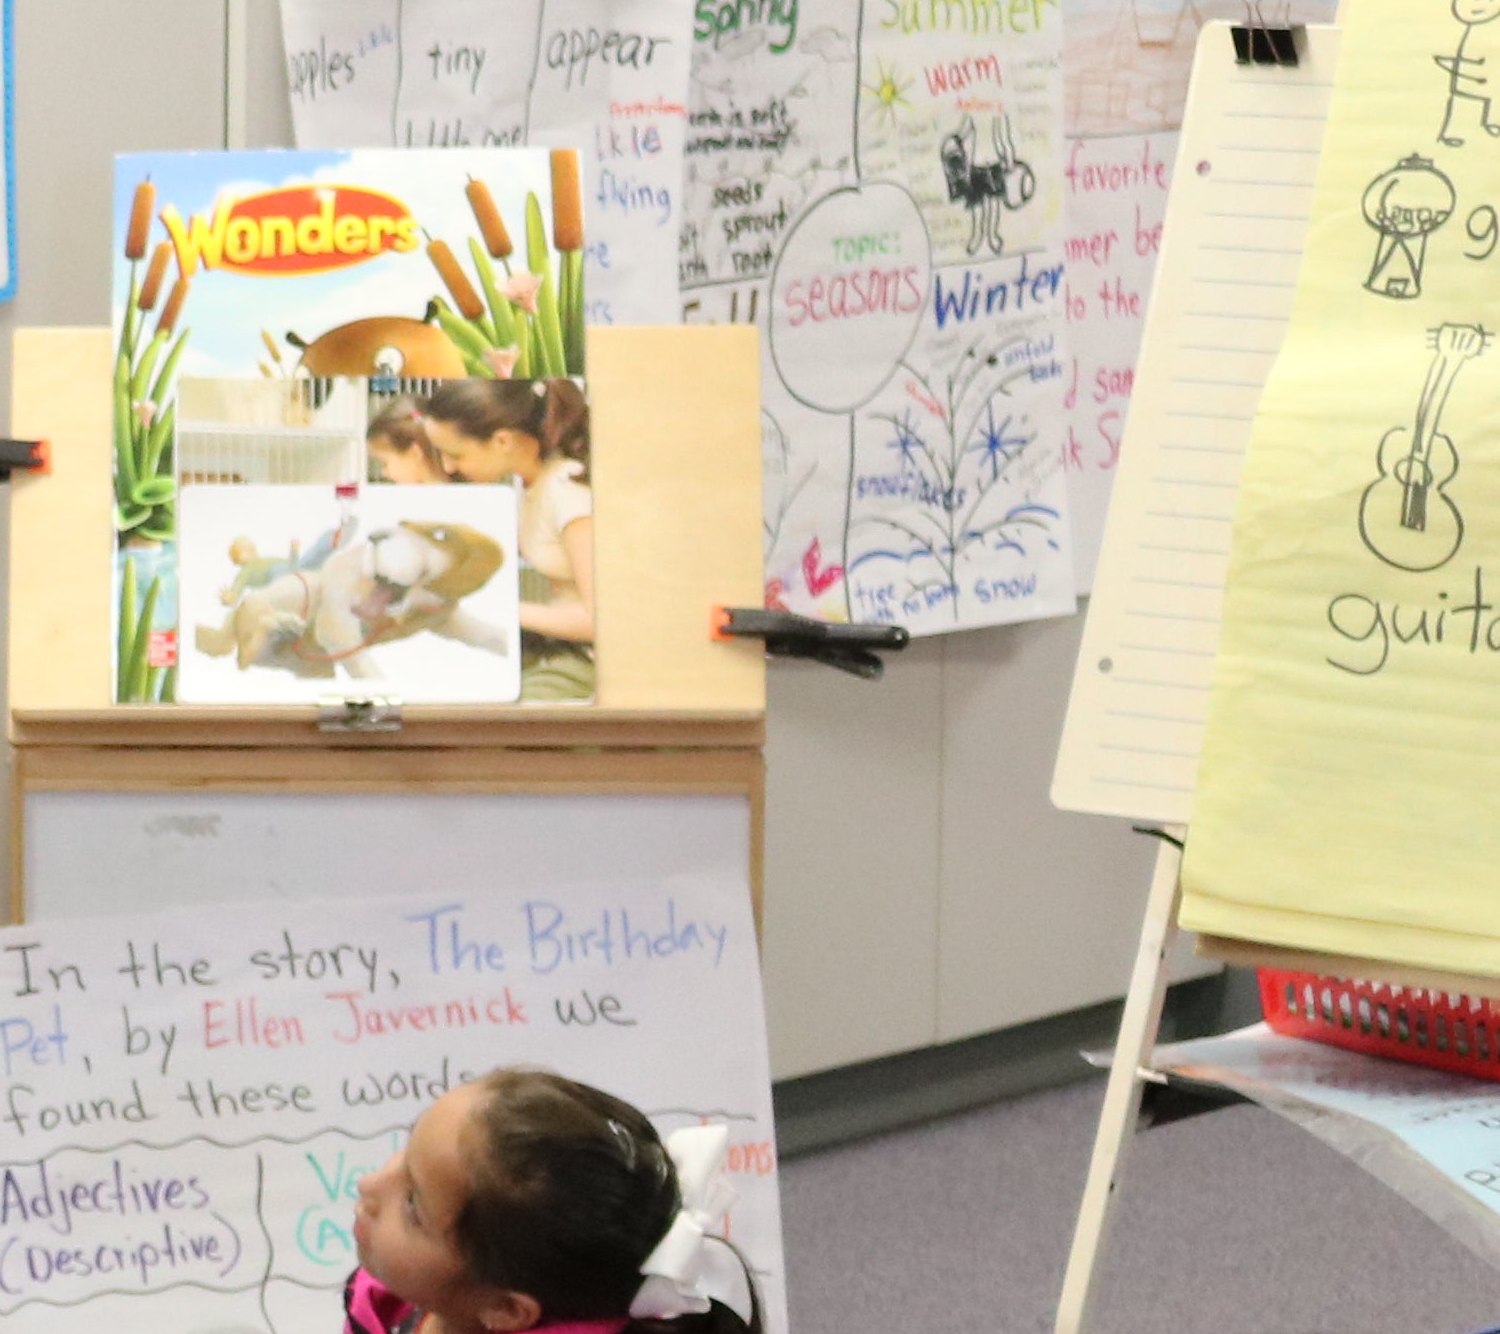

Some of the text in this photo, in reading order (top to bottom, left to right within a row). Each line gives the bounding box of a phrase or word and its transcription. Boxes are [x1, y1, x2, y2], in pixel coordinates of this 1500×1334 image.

[427, 28, 673, 95] tiny appear
[923, 51, 1003, 99] warm
[159, 187, 420, 279] Wonders
[784, 252, 1067, 331] seasons Winter
[4, 900, 728, 997] In the story, The Birthday
[123, 1013, 178, 1073] by
[203, 998, 304, 1050] Ellen
[324, 984, 531, 1045] Javernick
[553, 993, 638, 1027] we
[1, 1076, 316, 1137] found these
